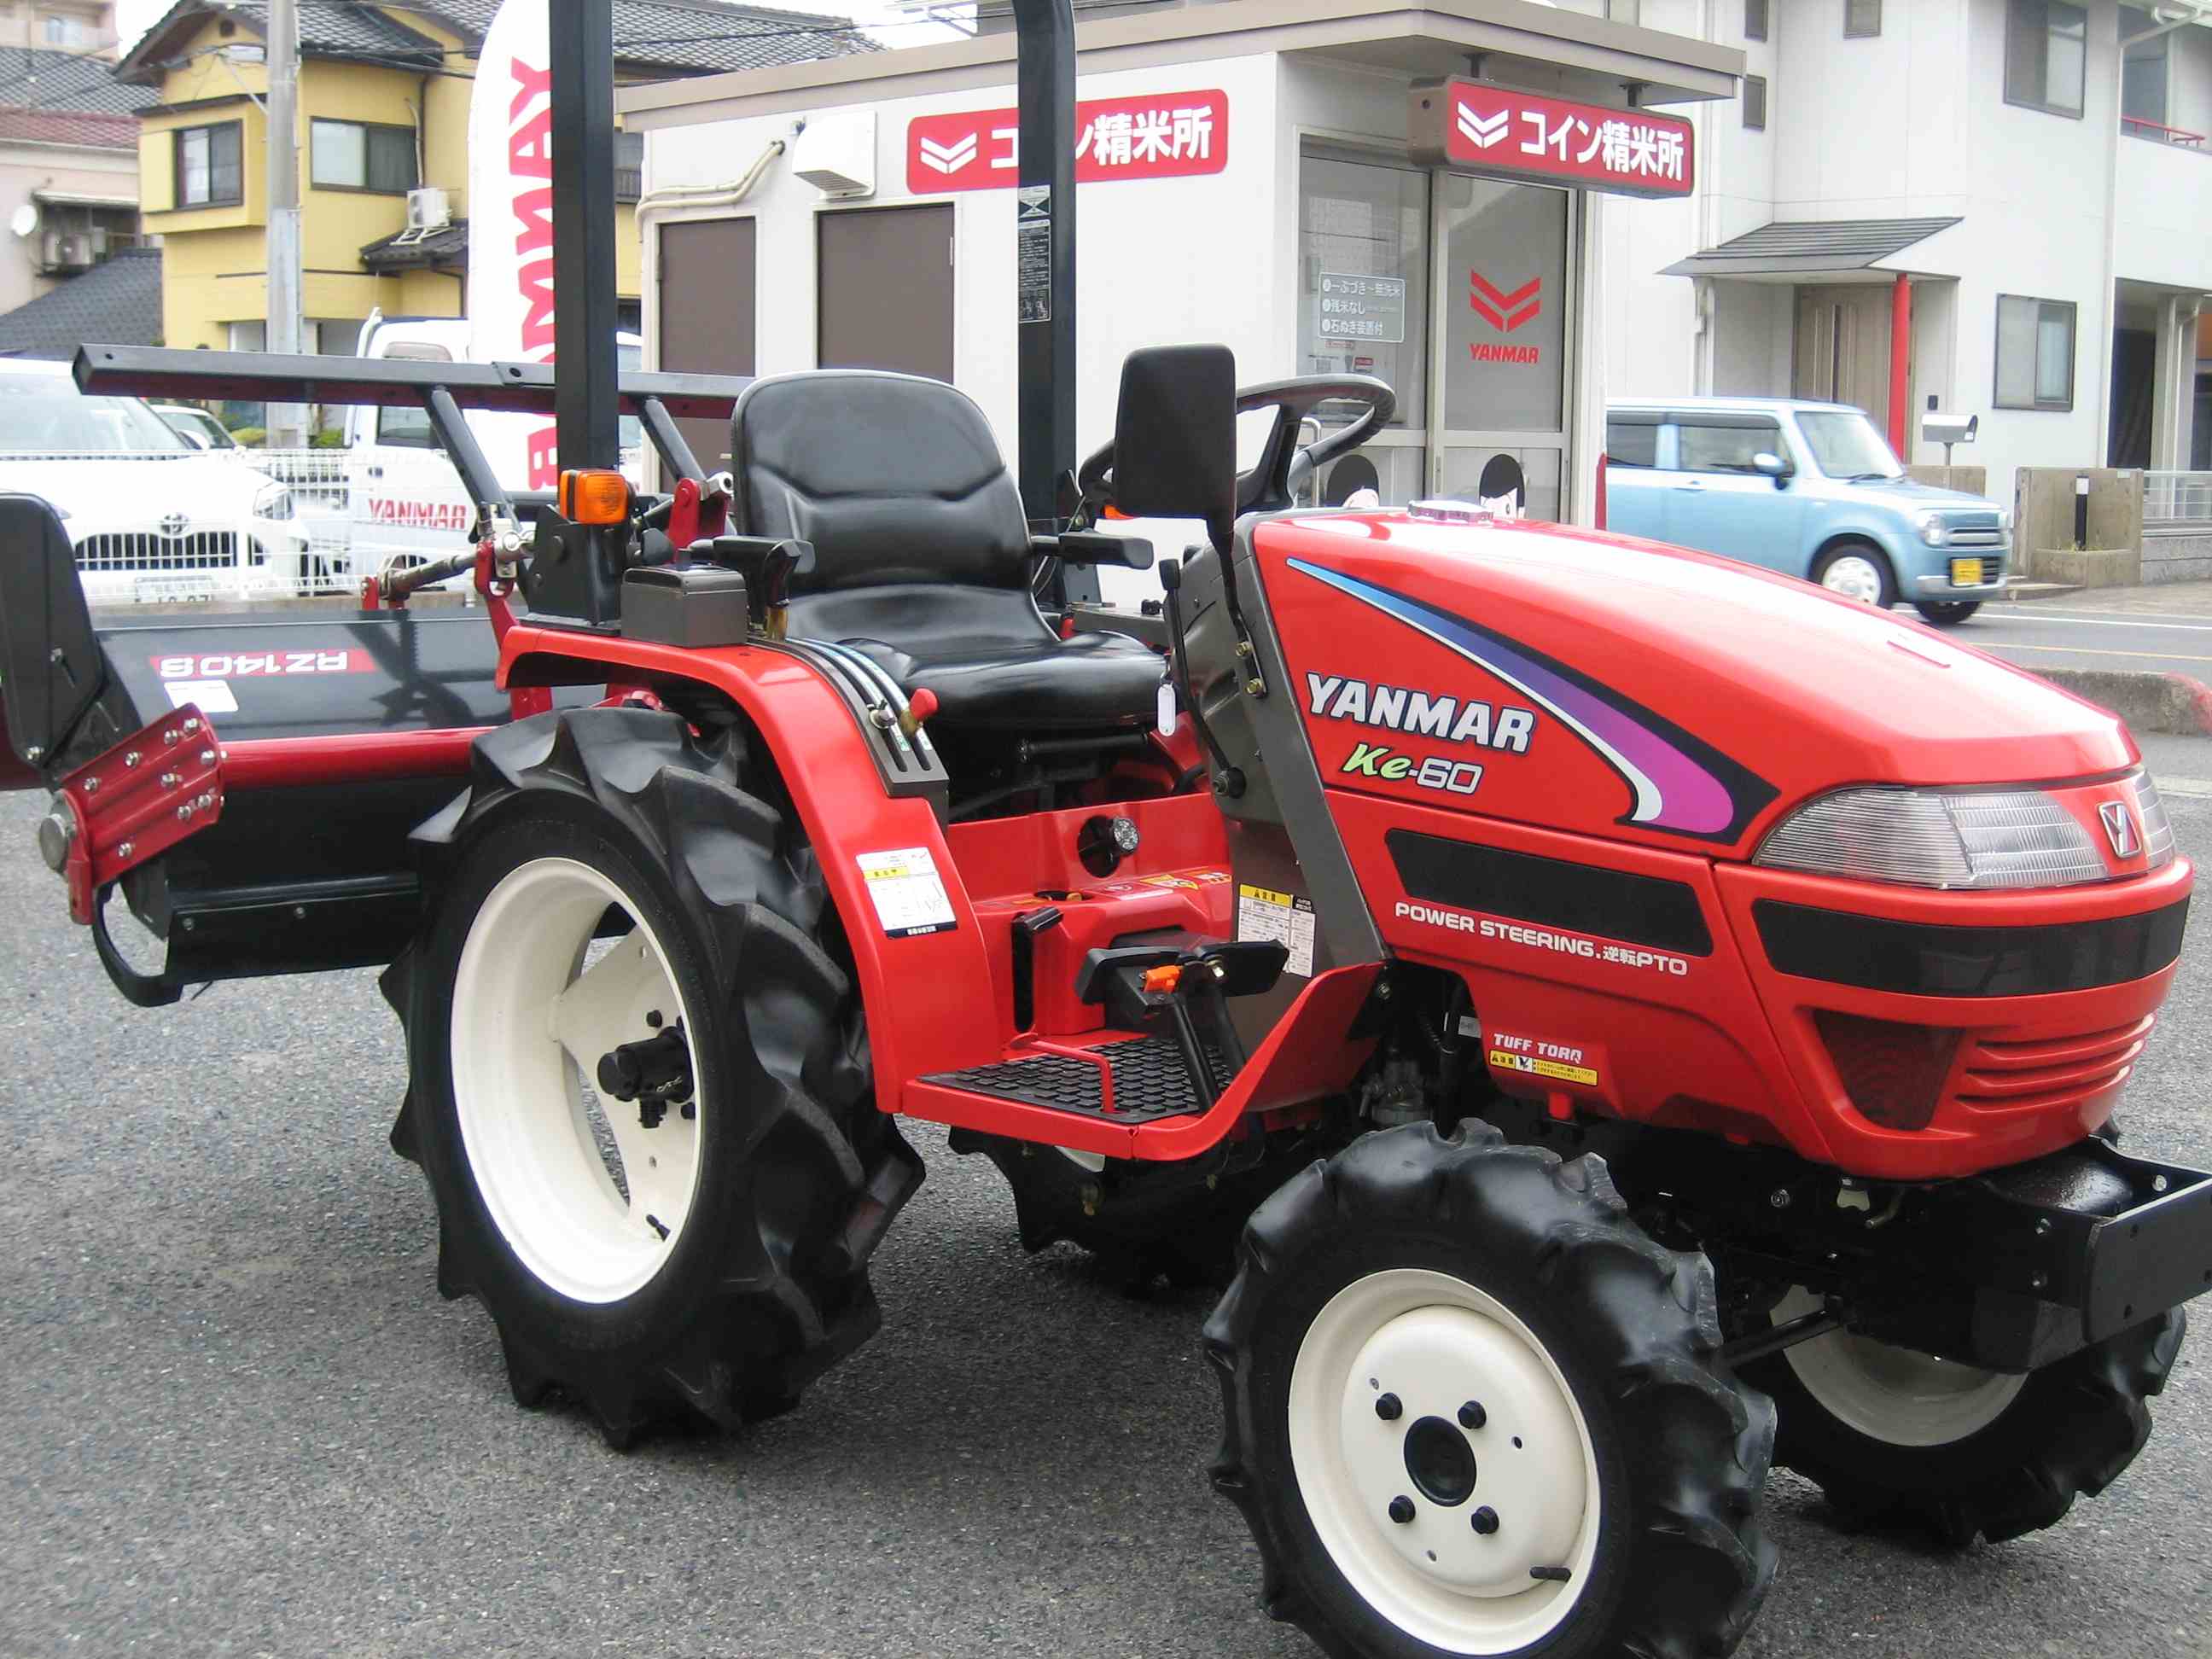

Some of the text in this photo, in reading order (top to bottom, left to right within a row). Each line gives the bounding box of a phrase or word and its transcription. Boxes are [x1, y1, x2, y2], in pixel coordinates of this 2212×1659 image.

[991, 106, 1213, 169] コ精米所
[1521, 110, 1685, 182] コイン精米所
[1469, 343, 1540, 364] YANMAR
[368, 498, 467, 529] YANMAR
[1307, 672, 1535, 753] YANMAR
[1342, 742, 1483, 795] Ke-60
[1394, 901, 1475, 934] POWER
[1493, 1033, 1533, 1051] TUFF
[1537, 1041, 1583, 1063] TORQ
